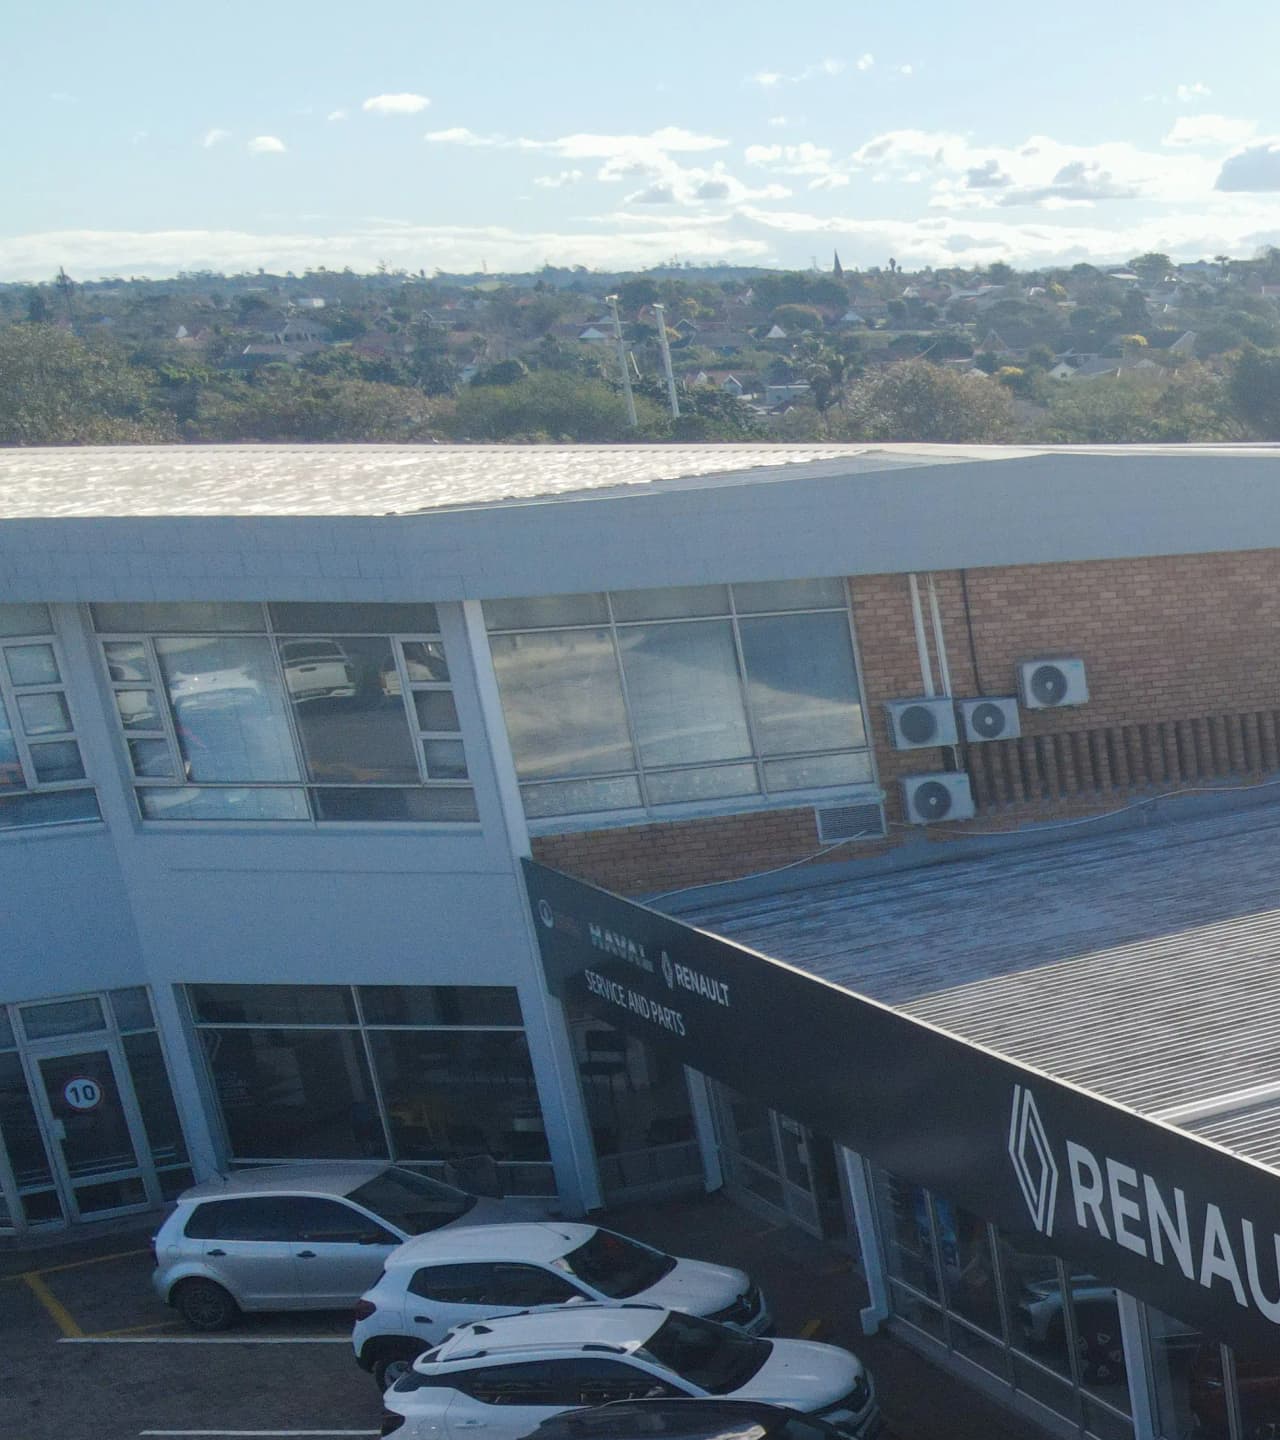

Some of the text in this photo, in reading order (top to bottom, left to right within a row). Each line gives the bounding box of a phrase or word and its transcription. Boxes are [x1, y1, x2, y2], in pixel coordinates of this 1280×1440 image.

[585, 969, 686, 1036] SERVICE AND PARTS
[674, 963, 729, 1007] RENAULT
[70, 1085, 95, 1103] 10
